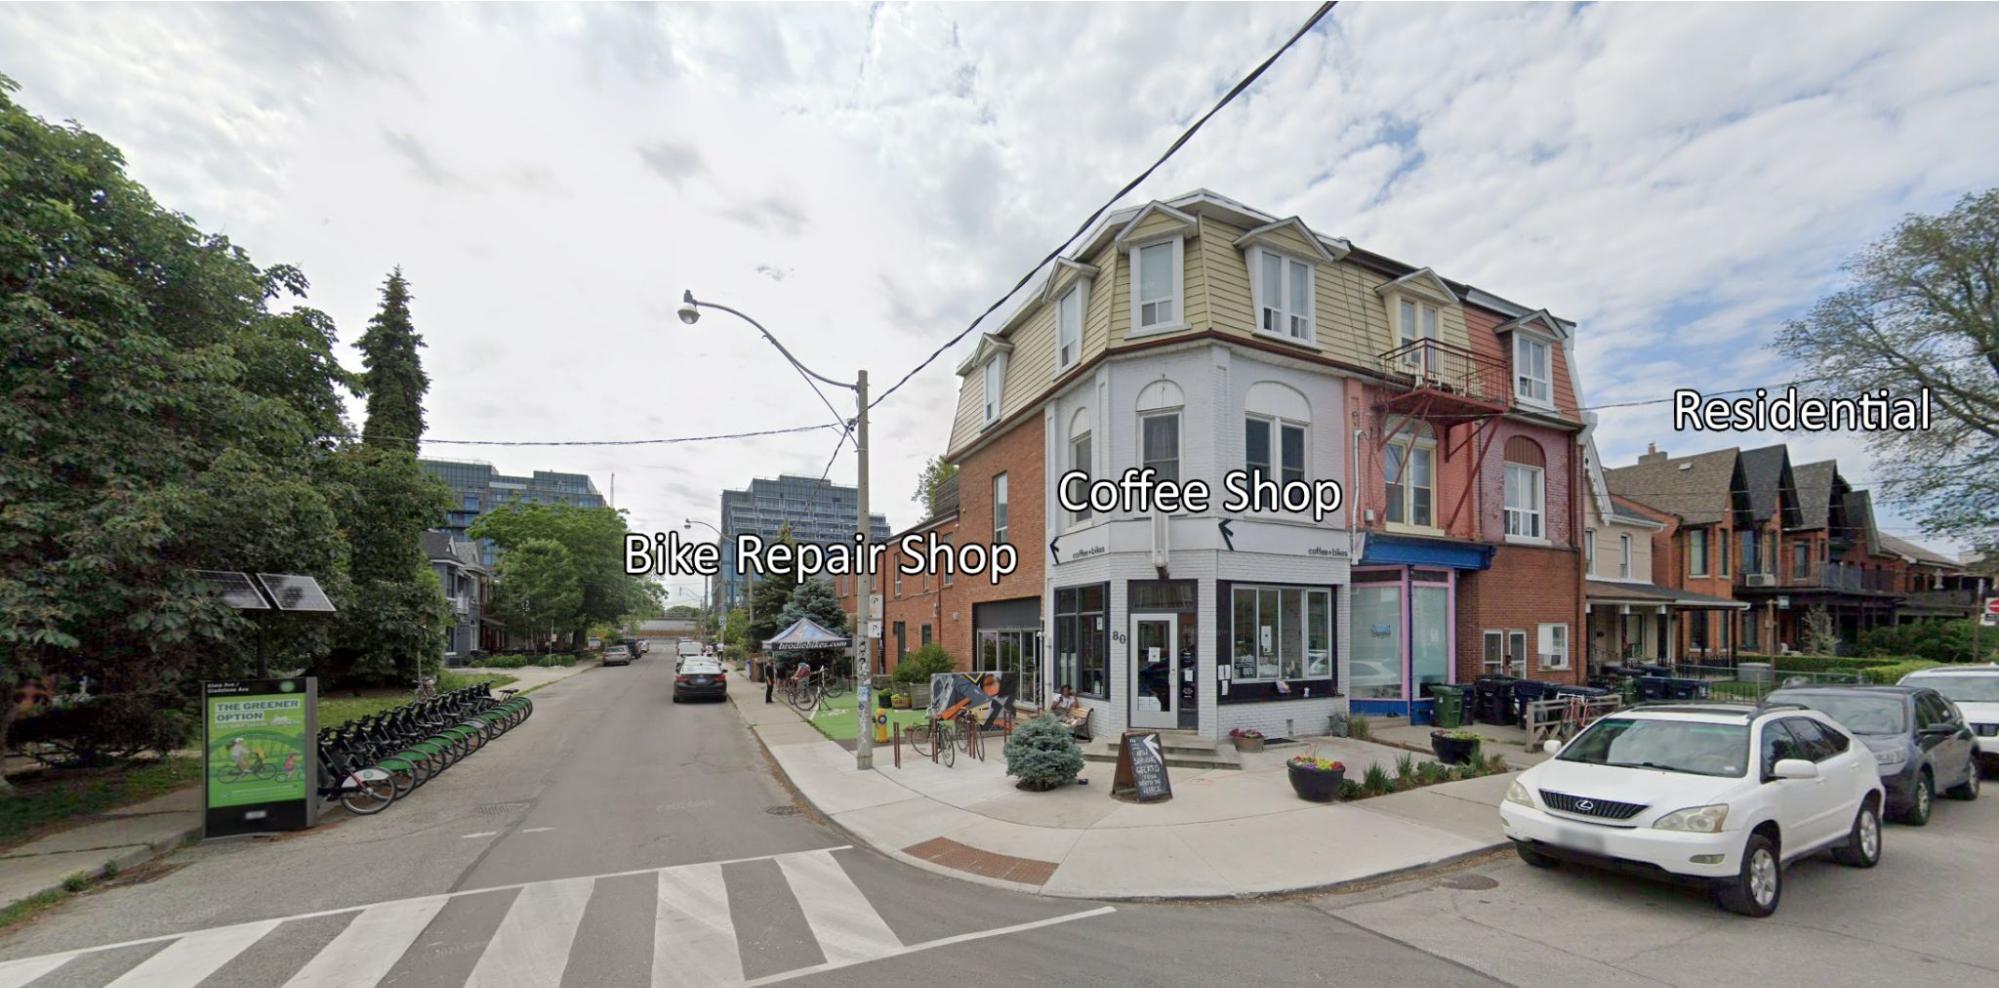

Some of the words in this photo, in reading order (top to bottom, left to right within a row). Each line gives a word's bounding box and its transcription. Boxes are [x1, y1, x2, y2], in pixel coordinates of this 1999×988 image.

[1112, 631, 1126, 644] 80
[217, 703, 241, 712] THE
[243, 700, 299, 710] GREENER
[217, 712, 263, 722] OPTION
